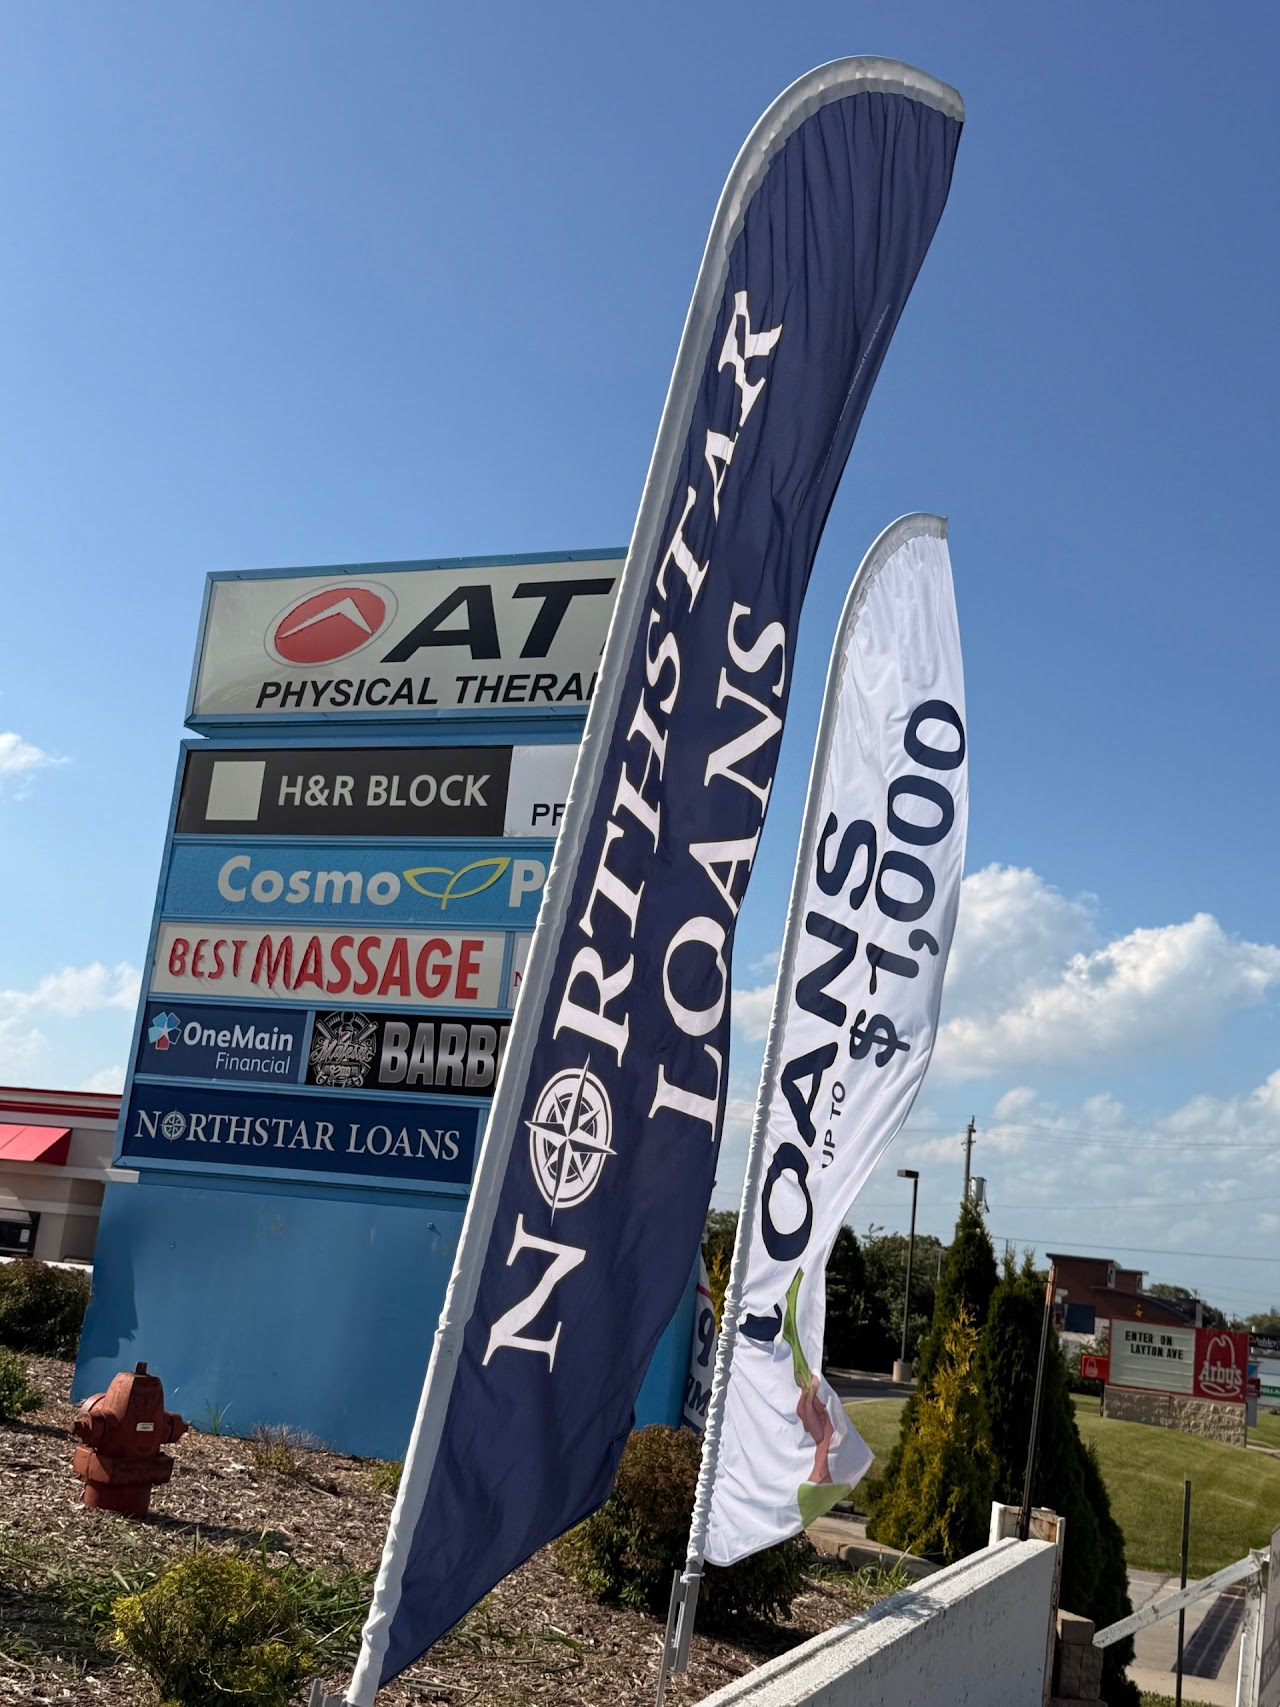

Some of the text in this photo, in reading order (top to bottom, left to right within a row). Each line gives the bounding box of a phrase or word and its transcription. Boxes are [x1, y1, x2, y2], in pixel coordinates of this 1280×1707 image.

[380, 577, 616, 664] AT
[256, 676, 439, 708] PHYSICAL
[278, 774, 491, 808] H&R BLOCK
[217, 855, 546, 908] Cosmo P
[648, 601, 786, 1142] LOANS
[849, 699, 966, 1068] $1,000
[168, 933, 485, 1000] BEST MASSAGE
[183, 1020, 294, 1053] OneMain
[215, 1051, 290, 1075] Financial
[821, 1080, 846, 1169] UP TO
[346, 1123, 460, 1161] LOANS
[1125, 1330, 1173, 1346] ENTER ON
[1130, 1343, 1184, 1360] LAYTON AVE
[1198, 1360, 1243, 1389] Arby's
[1260, 1386, 1280, 1395] OLLA
